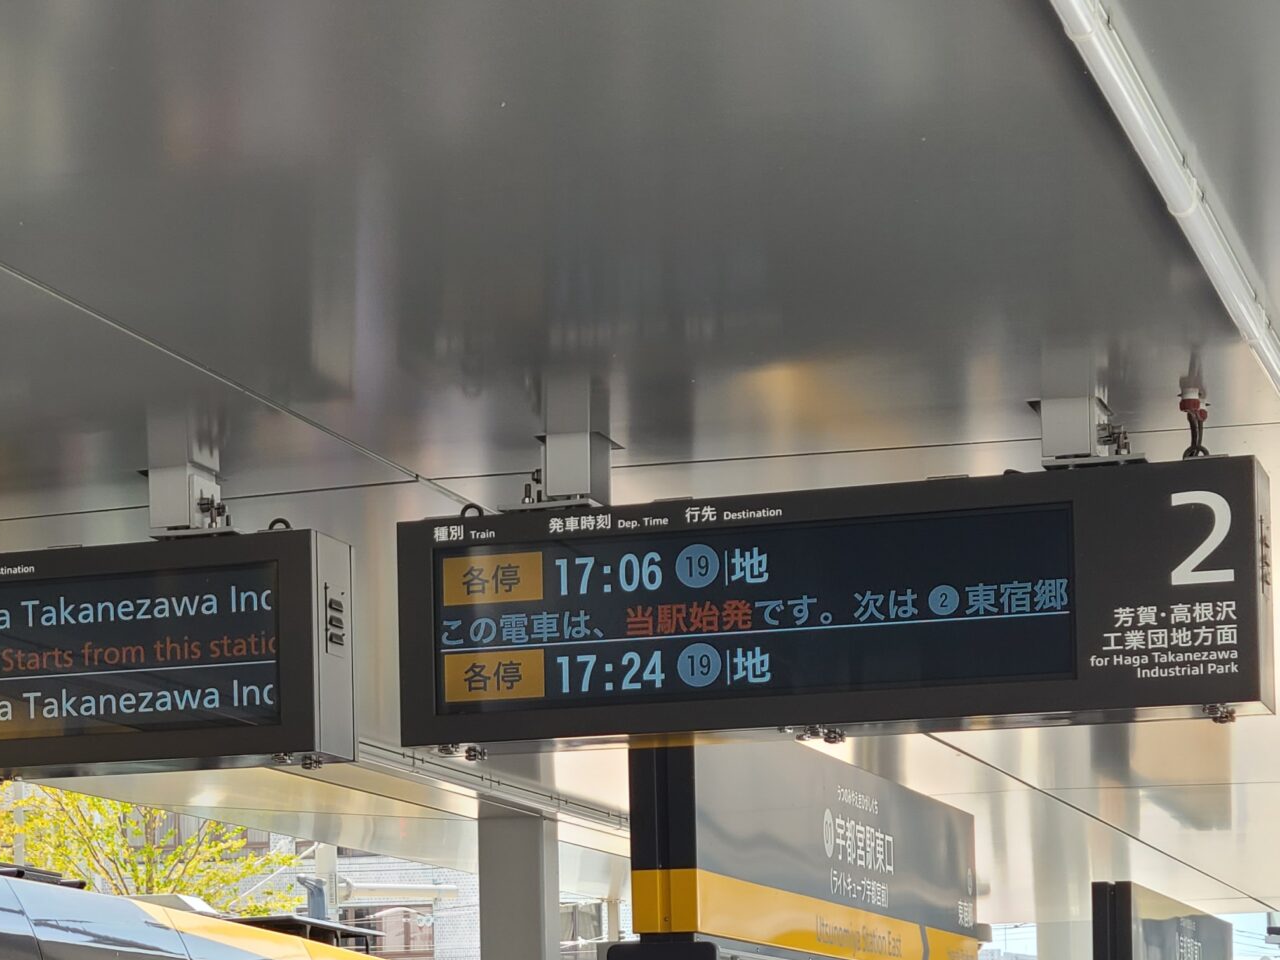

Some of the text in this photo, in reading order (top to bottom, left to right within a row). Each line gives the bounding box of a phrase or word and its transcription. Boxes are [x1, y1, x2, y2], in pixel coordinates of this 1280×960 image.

[549, 514, 669, 534] 発車時刻 Dep. Time
[685, 506, 783, 523] 行先 Destination
[433, 525, 495, 542] 種別 Train
[1169, 490, 1236, 586] 2
[462, 563, 521, 596] 各停
[554, 551, 663, 597] 17:06
[21, 592, 218, 628] Takanezawa
[1114, 600, 1238, 628] 芳賀・高根沢
[1102, 624, 1238, 650] 工業団地方面
[1, 646, 74, 673] Starts
[81, 640, 146, 667] from
[154, 633, 202, 662] this
[1090, 649, 1238, 668] for Haga Takanezawa
[463, 661, 523, 693] 各停
[556, 650, 666, 693] 17:24
[1137, 661, 1239, 679] Industrial Park
[23, 685, 220, 720] Takanezawa
[835, 813, 894, 876] 宇都宮駅東口
